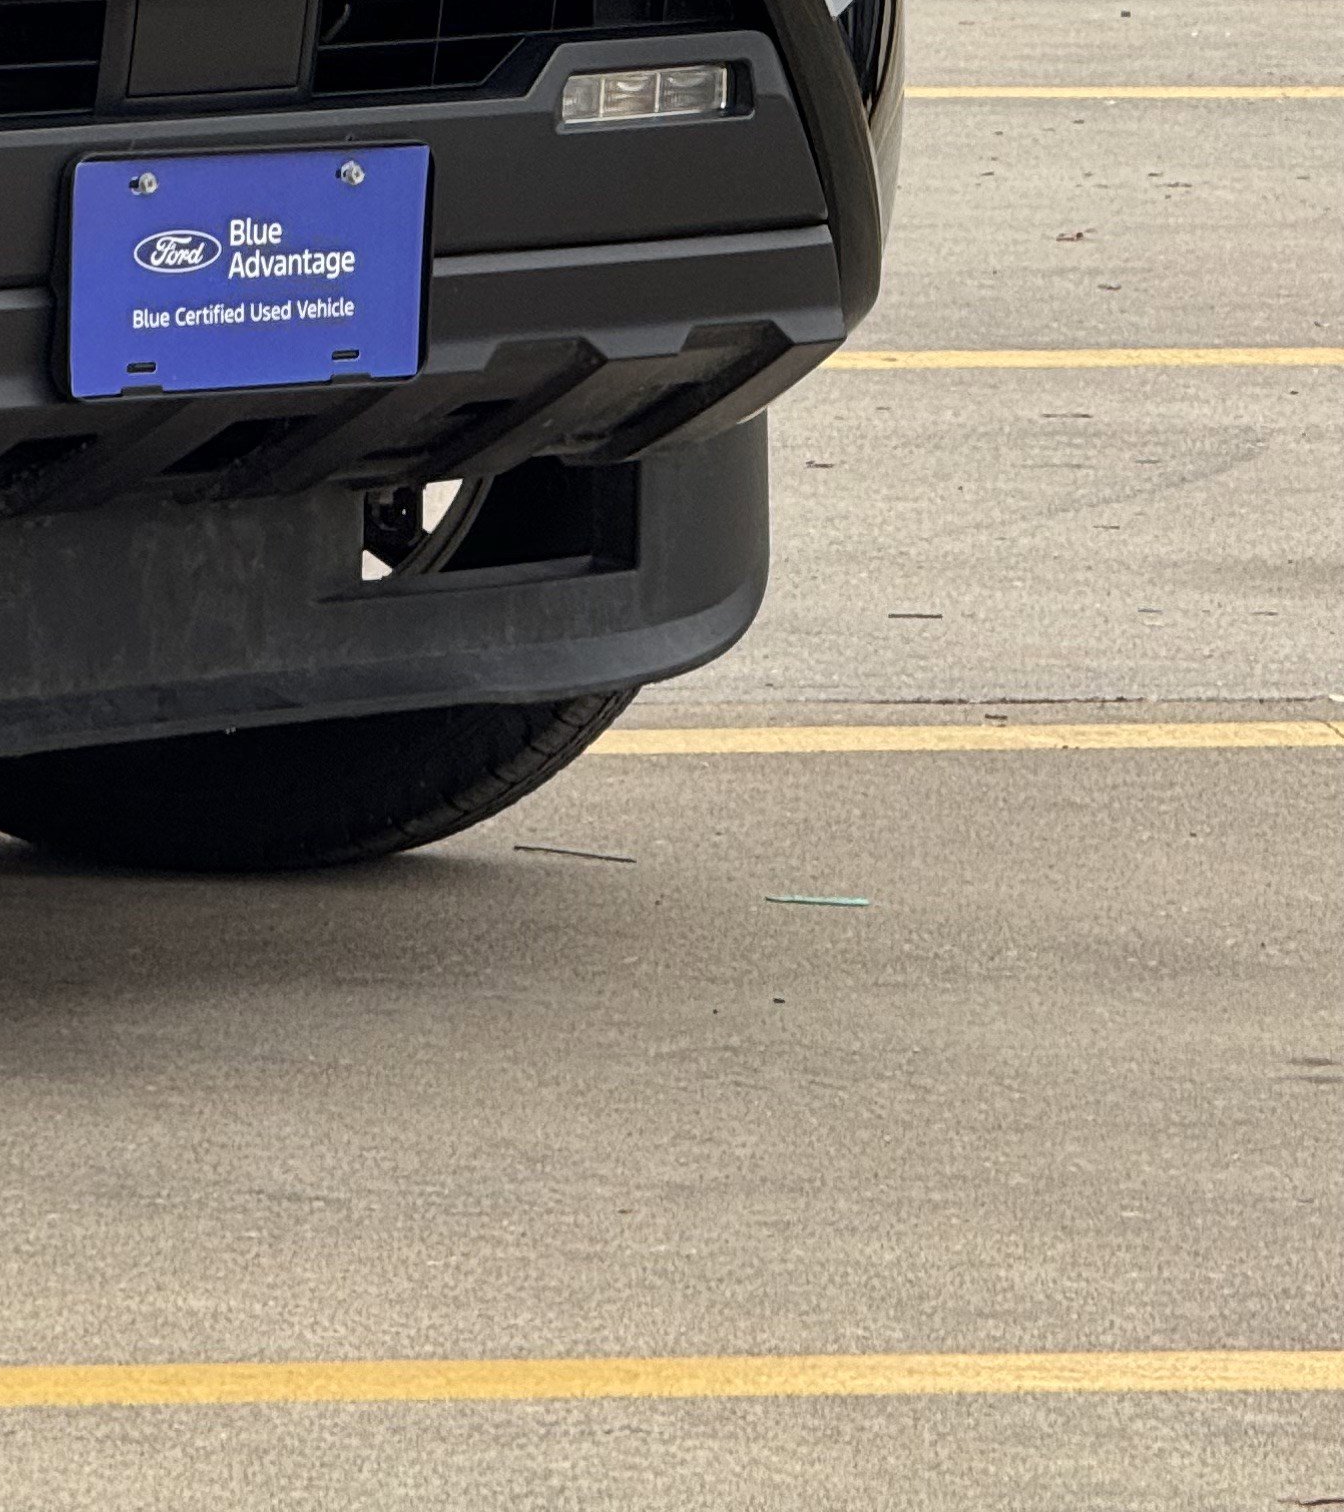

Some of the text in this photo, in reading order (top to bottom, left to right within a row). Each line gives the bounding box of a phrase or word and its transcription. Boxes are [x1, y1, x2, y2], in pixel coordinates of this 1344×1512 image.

[229, 217, 283, 247] Blue
[149, 235, 206, 267] Ford
[227, 248, 356, 280] Advantage
[132, 296, 355, 329] Blue Certified Used Vehicle
